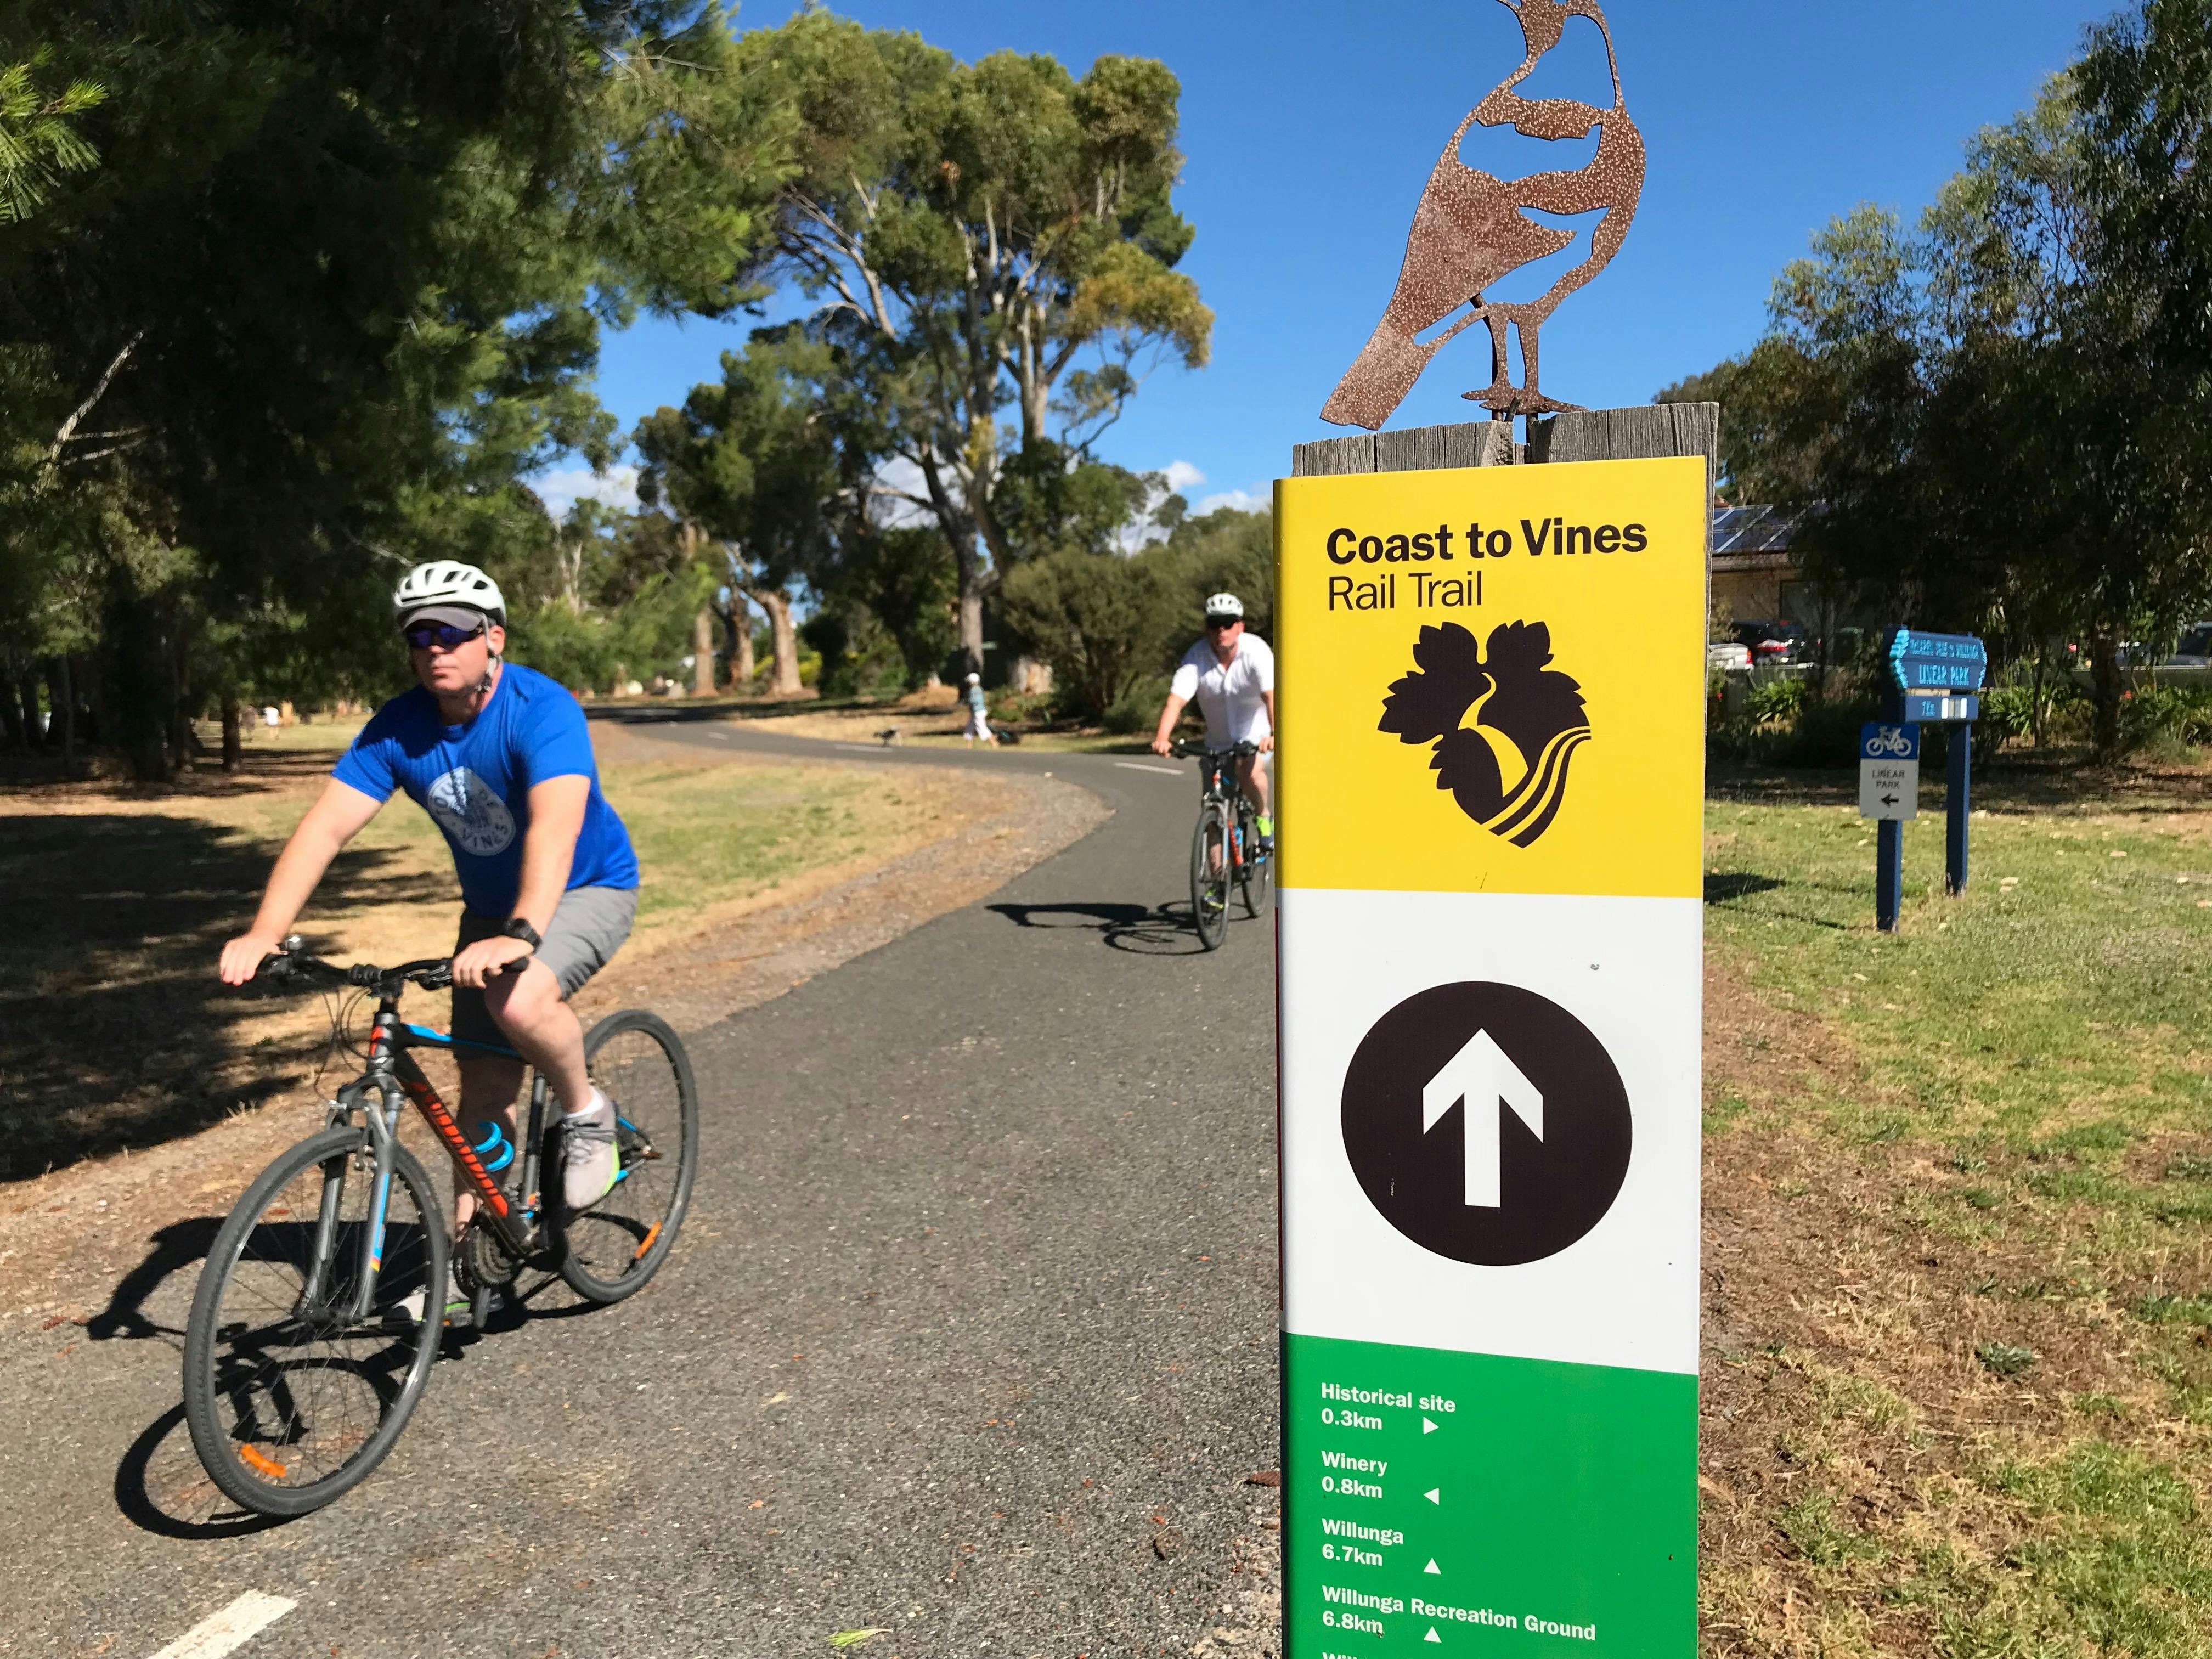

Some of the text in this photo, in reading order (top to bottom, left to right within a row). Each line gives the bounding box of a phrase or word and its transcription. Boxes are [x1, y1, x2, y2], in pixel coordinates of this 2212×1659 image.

[1327, 517, 1647, 565] Coast to Vines
[1329, 570, 1482, 611] Rail Trail
[1919, 664, 1969, 686] LINEAR PARK
[1872, 769, 1905, 779] LINEAR
[1876, 780, 1900, 789] PARK
[1322, 1383, 1456, 1413] Historical site
[1321, 1408, 1383, 1430] 0.3km
[1321, 1451, 1388, 1477] Winery
[1322, 1476, 1383, 1499] 0.8km
[1322, 1518, 1404, 1546] Willunga
[1322, 1543, 1383, 1566] 6.7km
[1322, 1585, 1596, 1641] Willunga Recreation Ground
[1322, 1610, 1384, 1634] 6.8km
